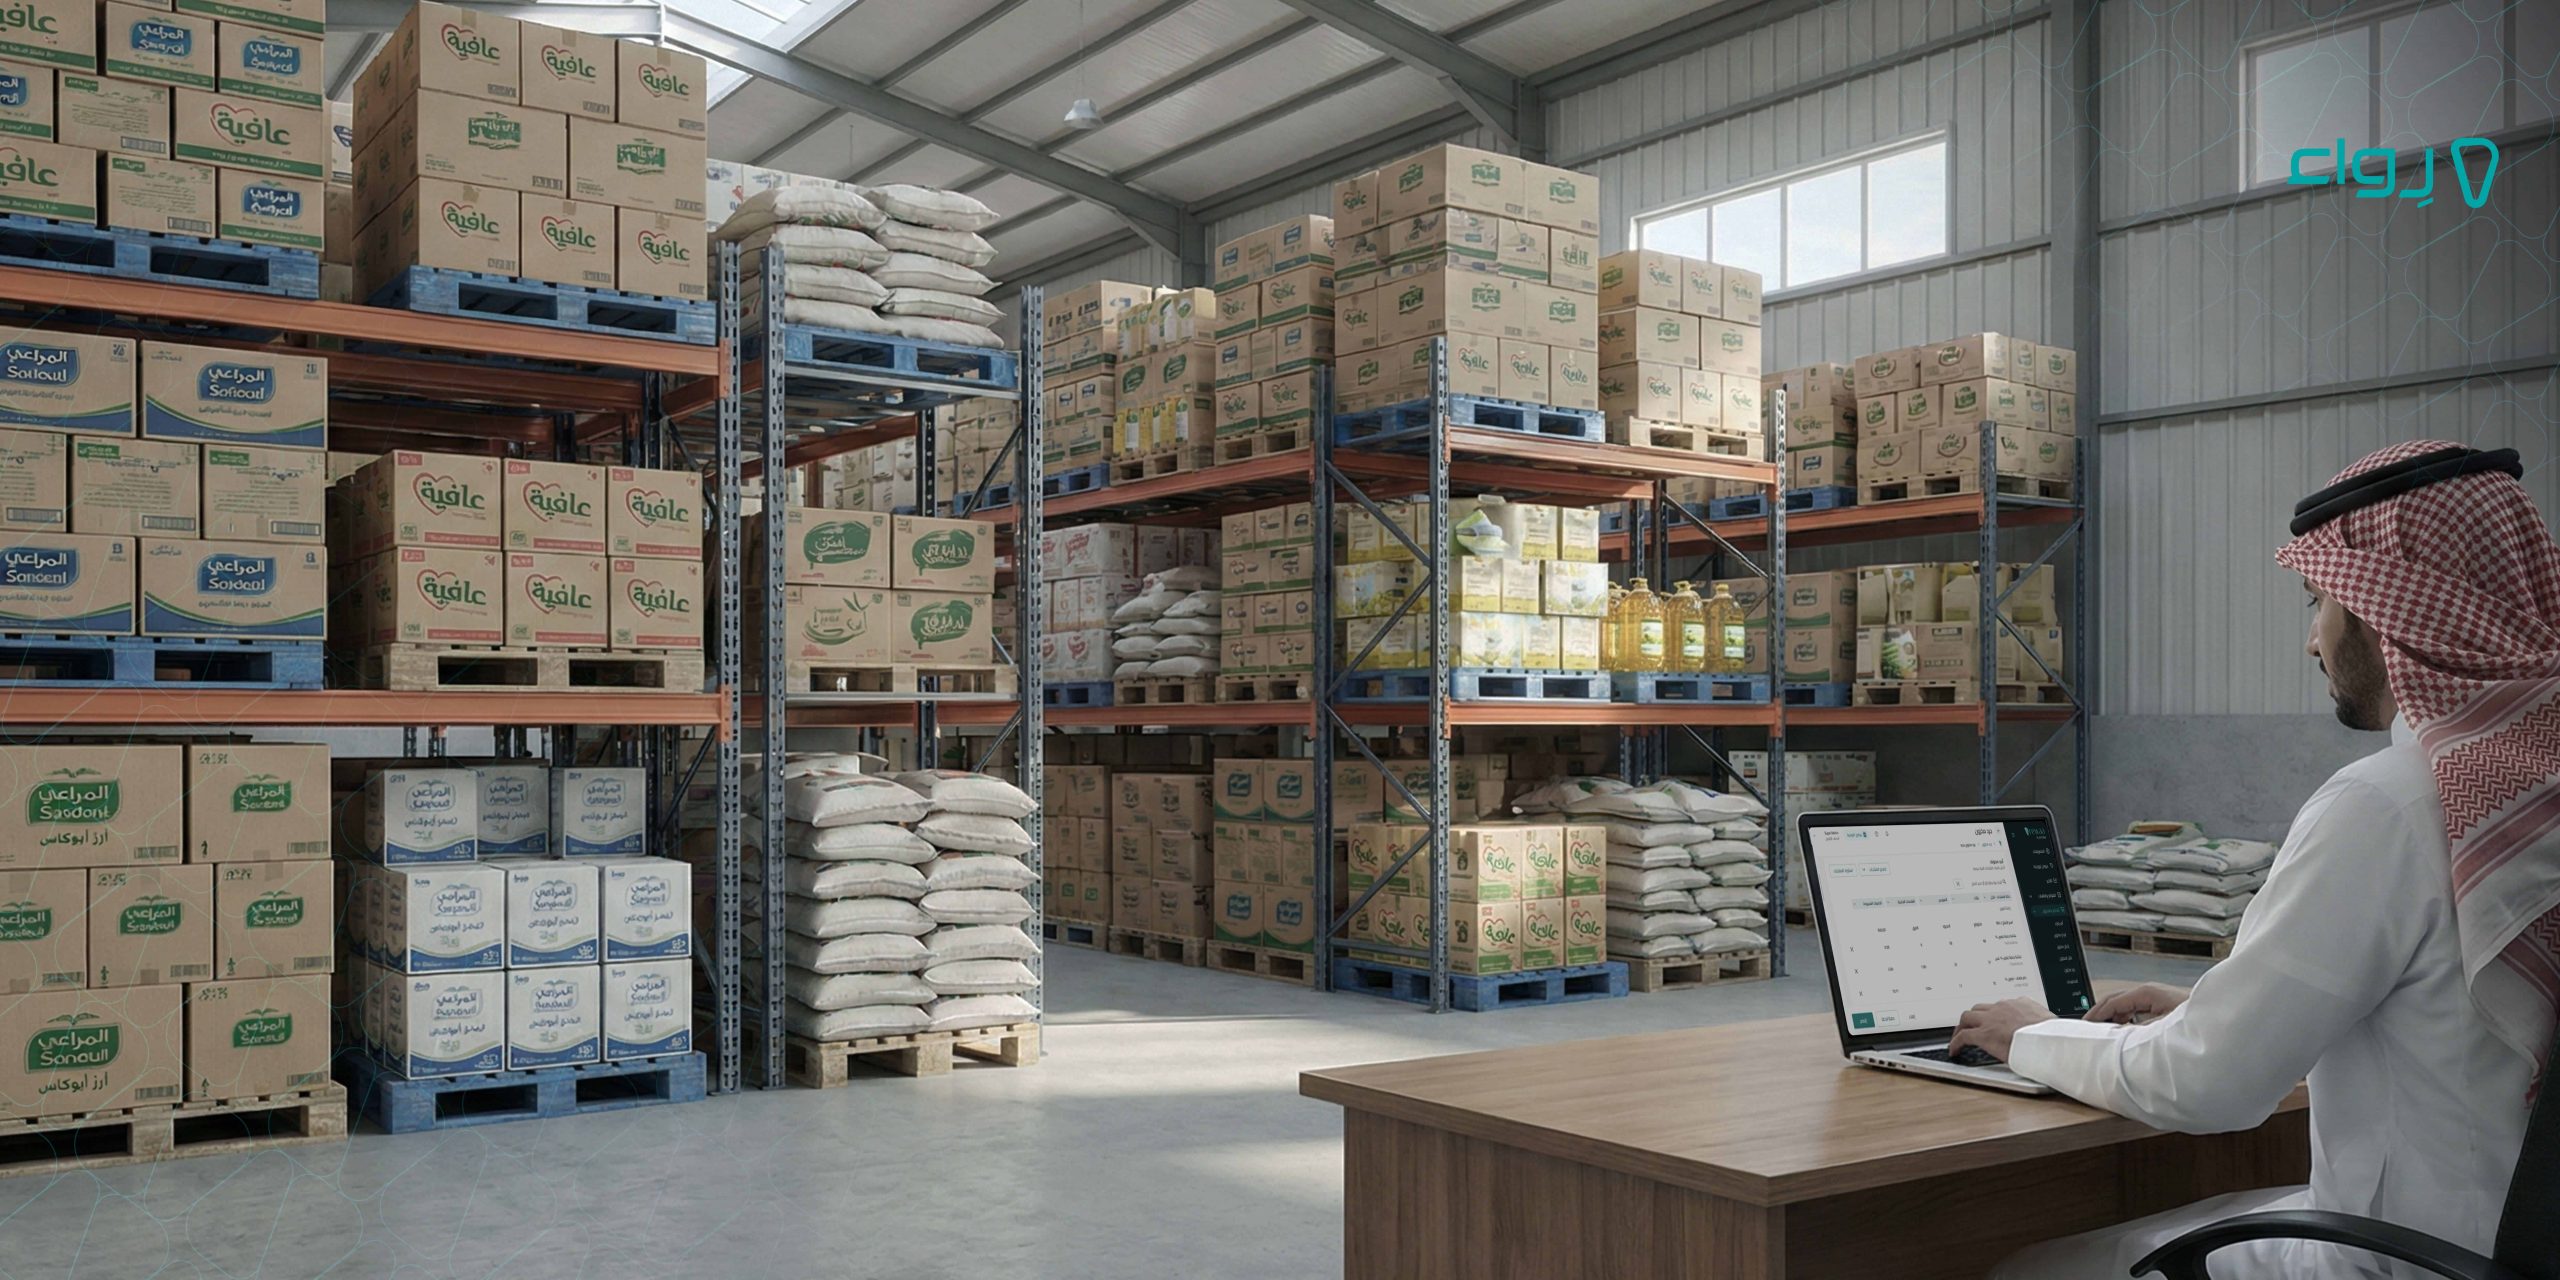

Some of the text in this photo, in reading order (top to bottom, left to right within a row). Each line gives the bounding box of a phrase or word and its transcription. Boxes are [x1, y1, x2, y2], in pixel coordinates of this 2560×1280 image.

[447, 31, 500, 58] عافية
[546, 51, 596, 76] عافية
[217, 111, 291, 145] عافية
[446, 206, 500, 235] عافية
[546, 222, 596, 248] عافية
[643, 237, 690, 263] عافية
[7, 350, 67, 365] المراعي
[209, 368, 264, 383] المراعي
[420, 481, 486, 510] عافية
[530, 489, 591, 519] عافية
[632, 495, 689, 522] عافية
[5, 553, 67, 568] المراعي
[423, 577, 486, 606] عافية
[532, 581, 592, 609] عافية
[633, 587, 690, 613] عافية
[39, 785, 109, 804] المراعي
[38, 1028, 109, 1049] المراعي
